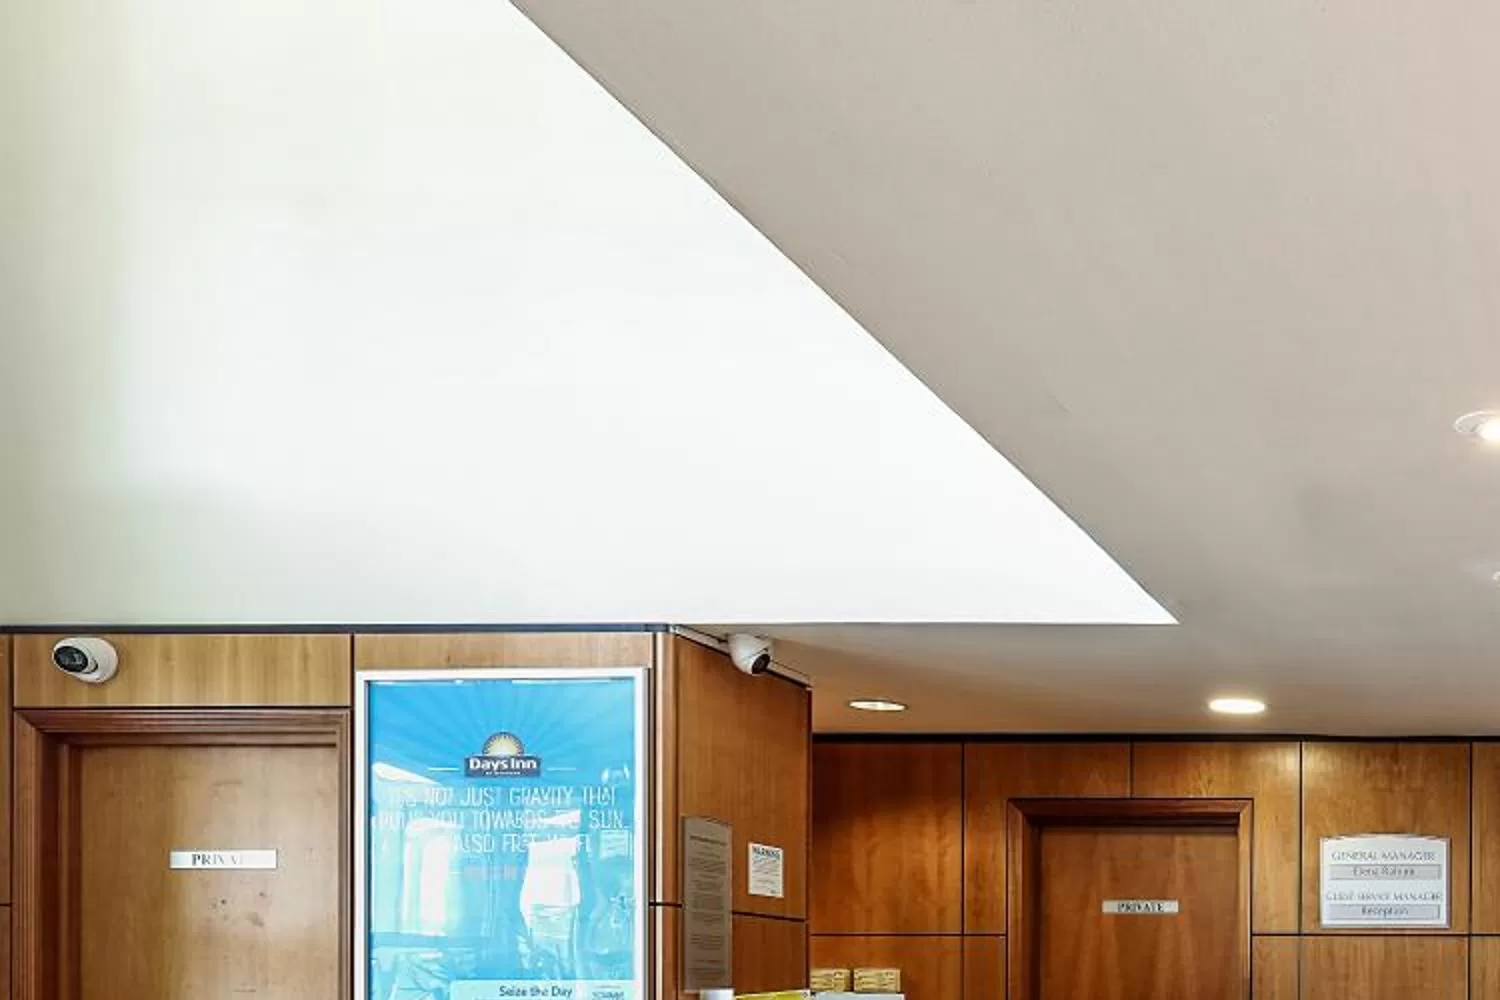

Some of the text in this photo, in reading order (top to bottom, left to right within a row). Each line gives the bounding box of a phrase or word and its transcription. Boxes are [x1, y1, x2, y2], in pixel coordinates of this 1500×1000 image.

[469, 757, 538, 772] Days Inn
[461, 787, 501, 807] JUST
[509, 787, 574, 806] GRAVITY
[583, 786, 618, 806] THAT
[1331, 851, 1436, 861] GENERAL MANAGER
[1117, 902, 1165, 913] PRIVATE
[1361, 904, 1409, 918] Reception
[499, 985, 573, 998] Seize the Day
